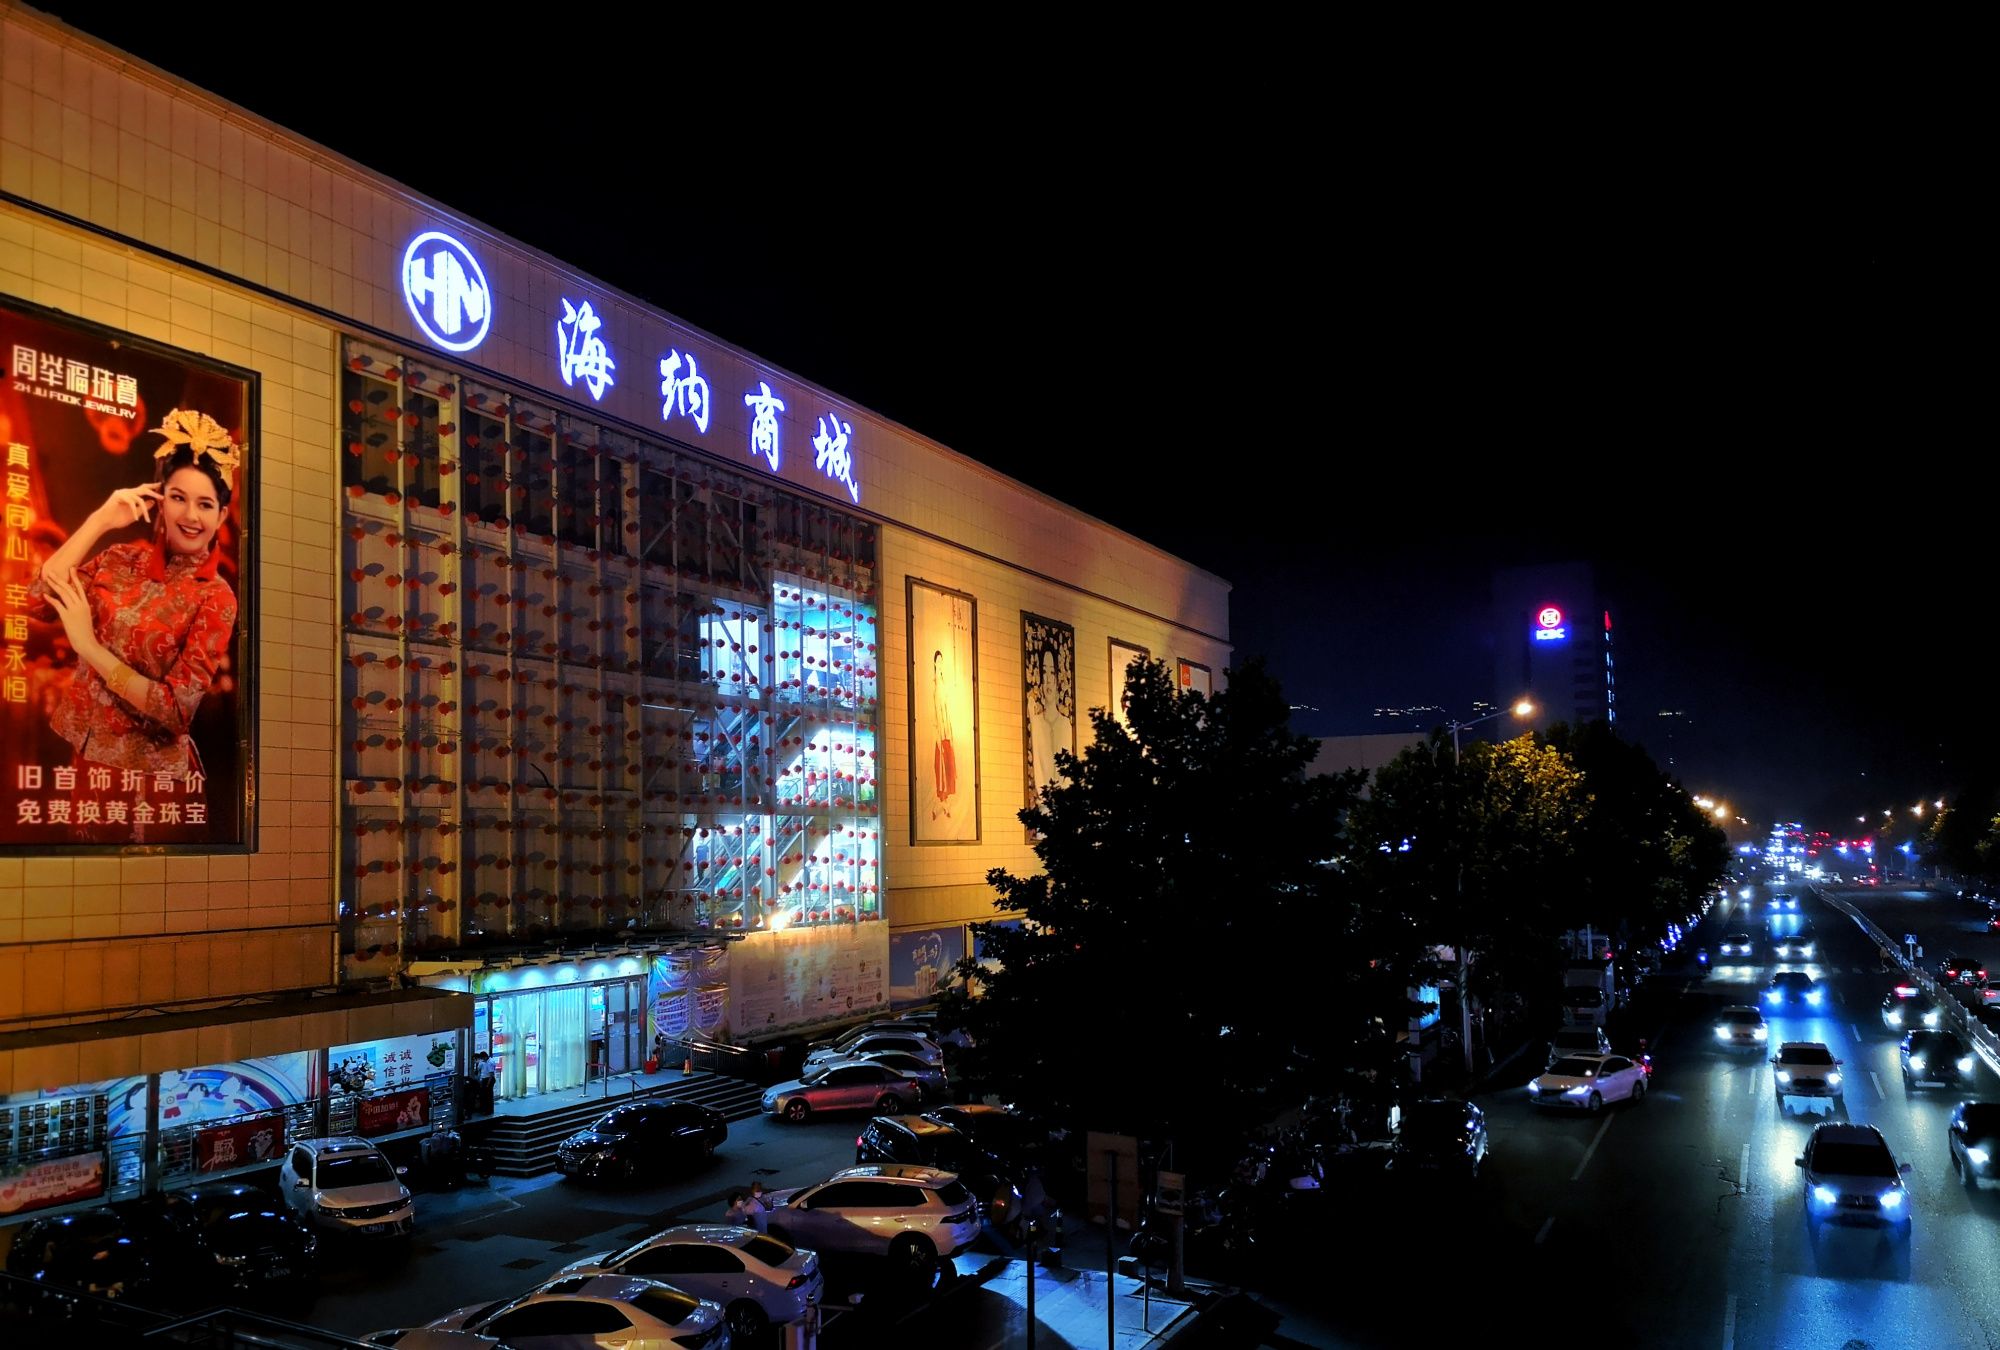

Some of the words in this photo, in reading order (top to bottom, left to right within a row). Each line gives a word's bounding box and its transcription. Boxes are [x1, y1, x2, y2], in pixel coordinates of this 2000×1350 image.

[410, 250, 485, 335] HN
[49, 390, 82, 407] FOOK
[557, 297, 859, 503] 海纳商城
[18, 764, 206, 793] 旧首饰折高价
[17, 798, 208, 825] 免费换黄金珠宝
